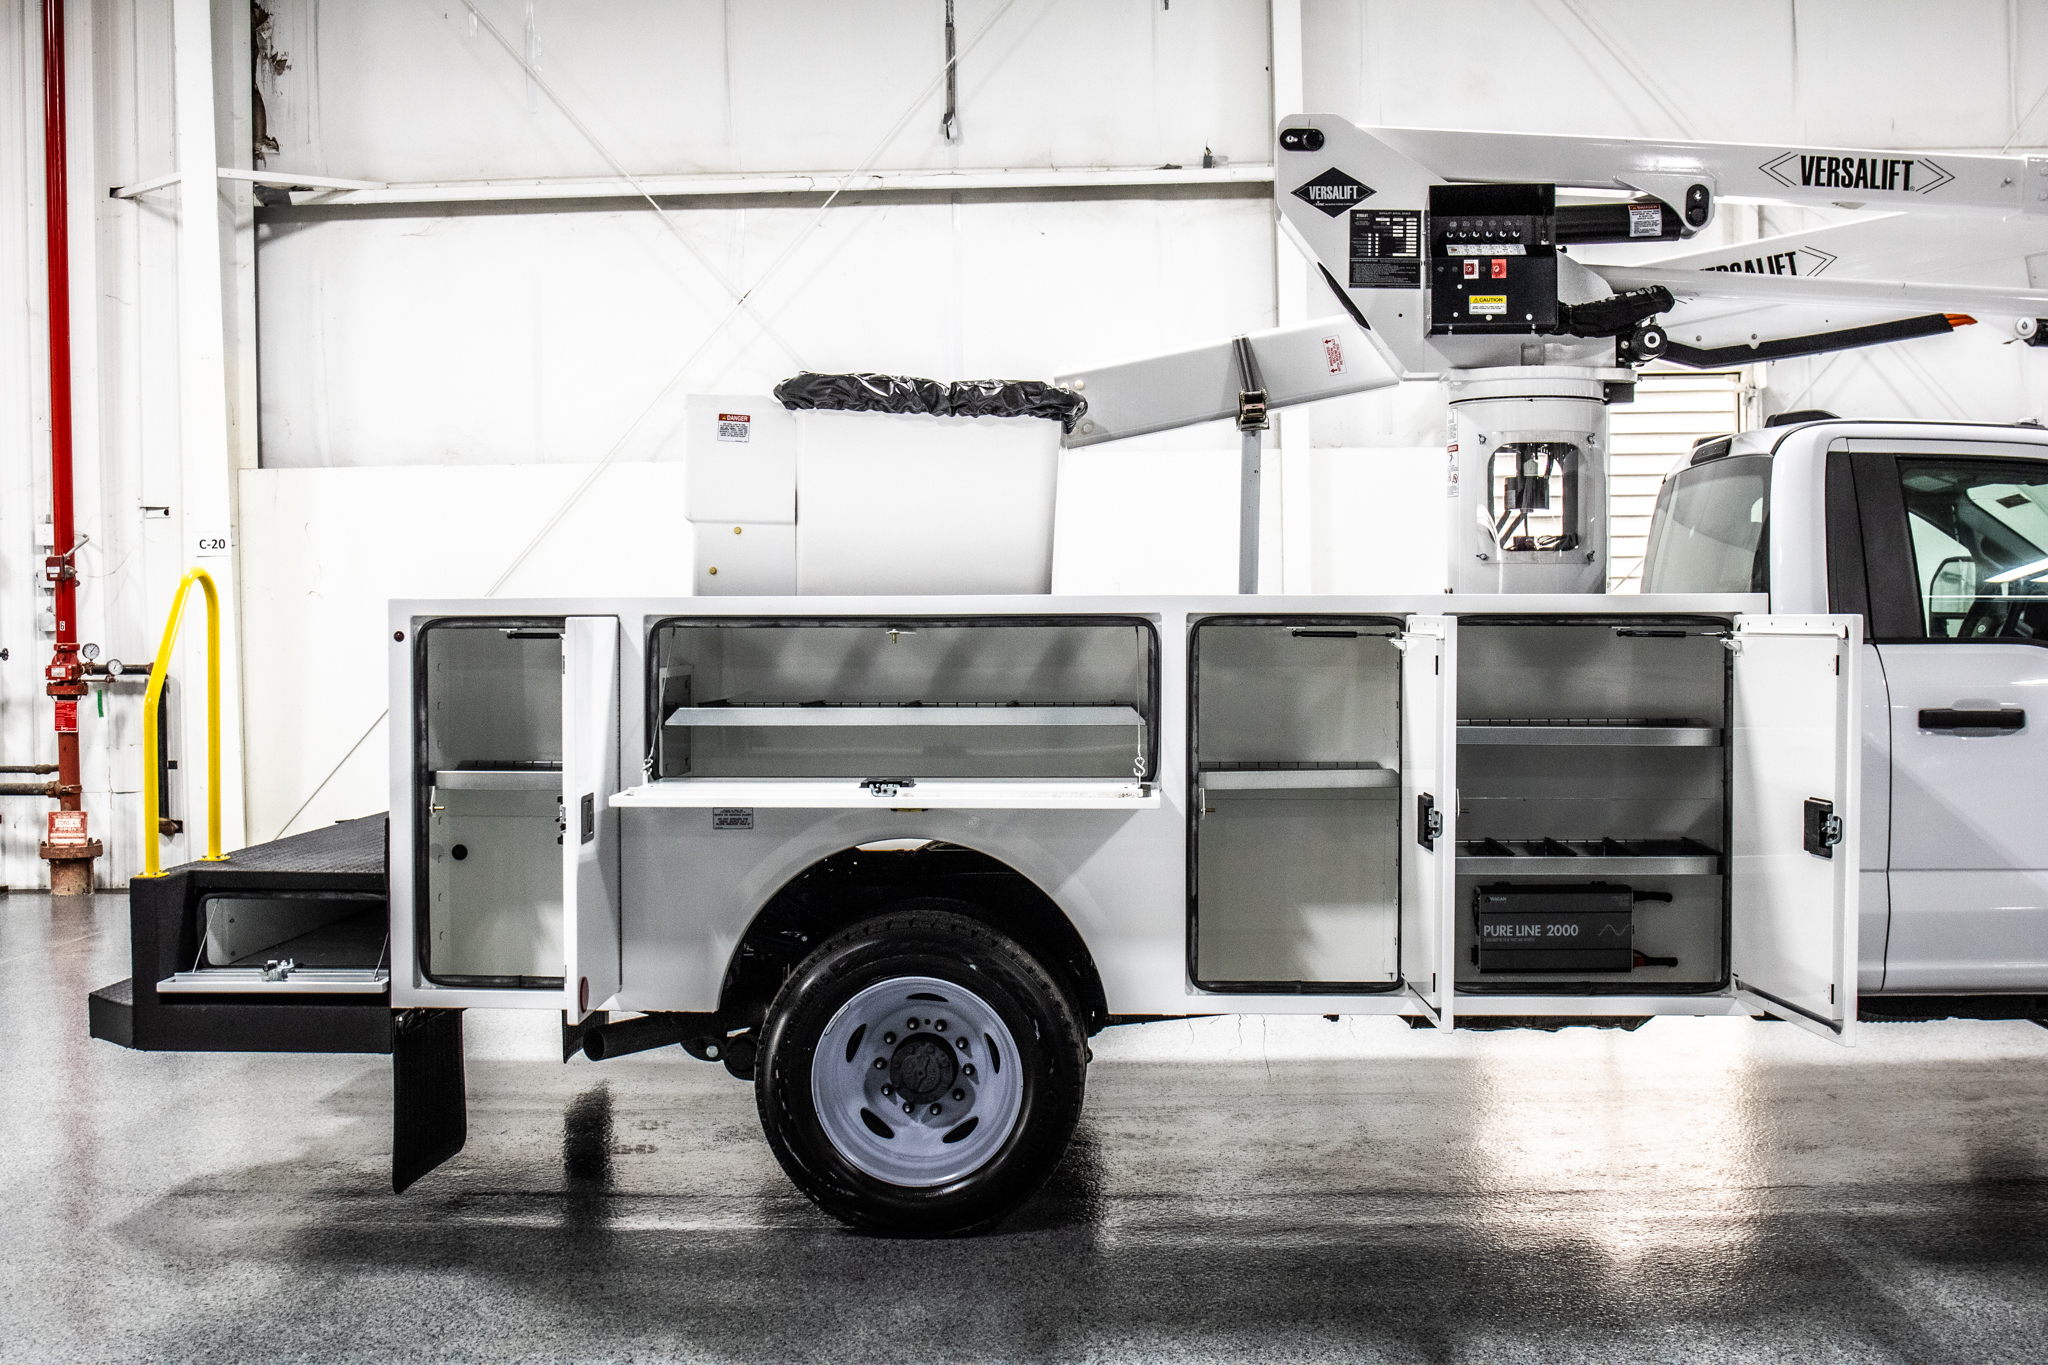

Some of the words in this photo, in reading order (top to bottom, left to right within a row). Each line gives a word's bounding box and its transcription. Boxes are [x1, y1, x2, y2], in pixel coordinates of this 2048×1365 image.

[1800, 155, 1914, 191] VERSALIFT
[1308, 185, 1358, 200] VERSALIFT
[199, 538, 226, 550] C-20
[1483, 924, 1513, 937] PURE
[1515, 924, 1541, 937] LINE
[1546, 924, 1579, 937] 2000
